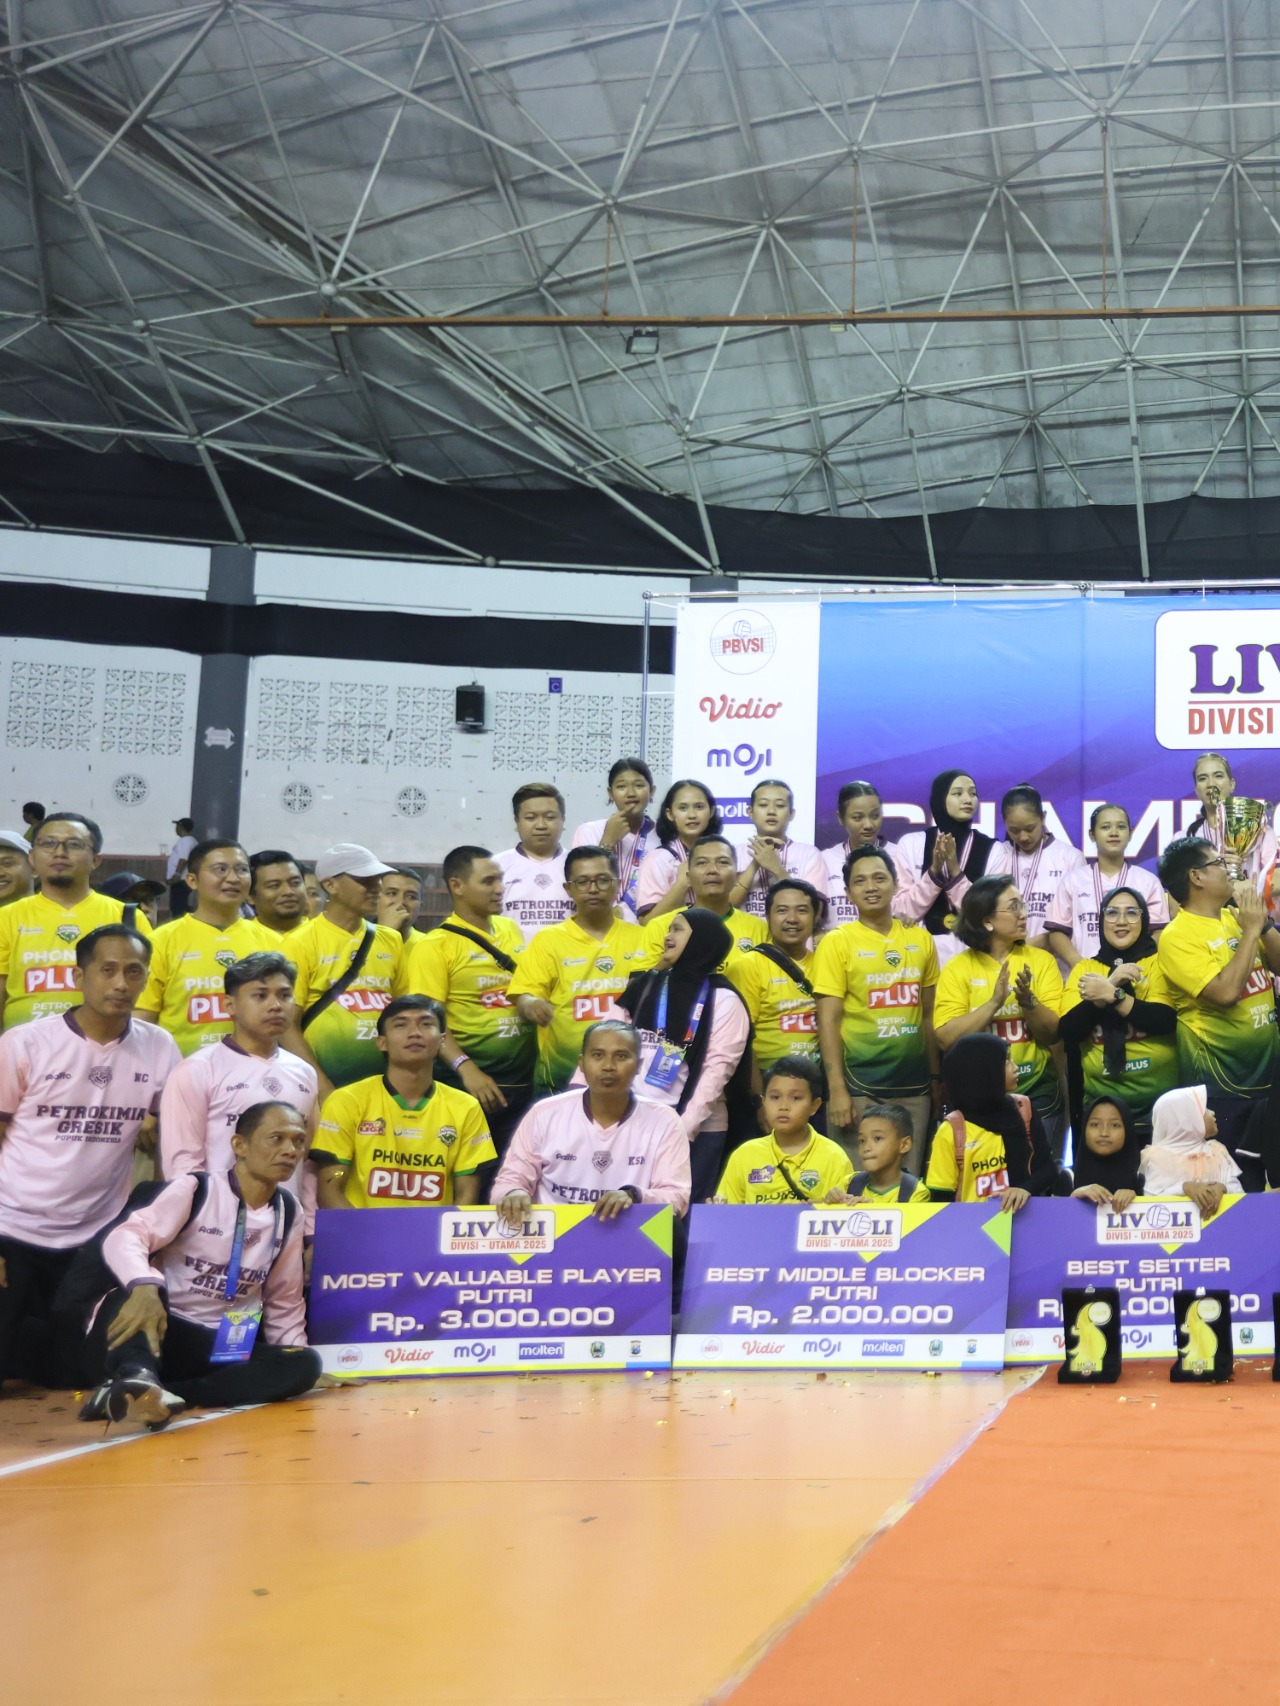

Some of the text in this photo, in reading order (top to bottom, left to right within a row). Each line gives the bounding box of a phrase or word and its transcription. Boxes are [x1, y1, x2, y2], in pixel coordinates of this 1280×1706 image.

[722, 637, 764, 654] PBVSI
[552, 683, 560, 691] C
[699, 694, 782, 722] Vidio
[1188, 708, 1274, 735] DIVISI
[715, 802, 750, 818] olt
[746, 903, 766, 913] GRE
[1028, 903, 1047, 912] SIK
[520, 911, 566, 920] GRESIK
[23, 950, 76, 963] PHON
[27, 968, 76, 993] PL
[870, 984, 919, 1007] PLUS
[33, 1002, 73, 1011] PETRO
[190, 996, 230, 1021] PL
[576, 995, 614, 1018] PL
[782, 1014, 818, 1031] PL
[877, 1017, 906, 1025] PETRO
[1253, 1014, 1268, 1028] ZA
[201, 1034, 223, 1042] PET
[356, 1028, 379, 1040] ZA
[499, 1026, 521, 1038] ZA
[878, 1027, 899, 1038] ZA
[1017, 1065, 1031, 1075] LUS
[1125, 1060, 1149, 1070] PLUS
[36, 1105, 147, 1121] PETROKIMIA
[57, 1120, 124, 1135] GRESIK
[972, 1155, 1007, 1171] PHON
[371, 1170, 440, 1198] PLUS
[978, 1170, 1009, 1196] PL
[552, 1183, 610, 1202] PETRO
[1106, 1230, 1193, 1240] DIVISI UTAMA 2025
[451, 1240, 546, 1250] DIVISI UTAMA 2025
[806, 1239, 893, 1248] DIVISI UTAMA 2025
[1066, 1257, 1230, 1275] BEST SETTER
[322, 1268, 661, 1290] MOST VALUABLE PLAYER
[706, 1267, 985, 1282] BEST MIDDLE BLOCKER
[193, 1275, 252, 1295] GREIK
[1115, 1277, 1182, 1292] PUTRI
[459, 1288, 533, 1304] PUTRI
[810, 1286, 878, 1300] PUTRI
[370, 1307, 615, 1336] Rp. 3.000.000
[731, 1305, 953, 1328] Rp. 2.000.000
[385, 1348, 434, 1363] Vidio
[520, 1344, 563, 1356] molten
[742, 1340, 785, 1355] Vidio
[863, 1341, 904, 1352] molten
